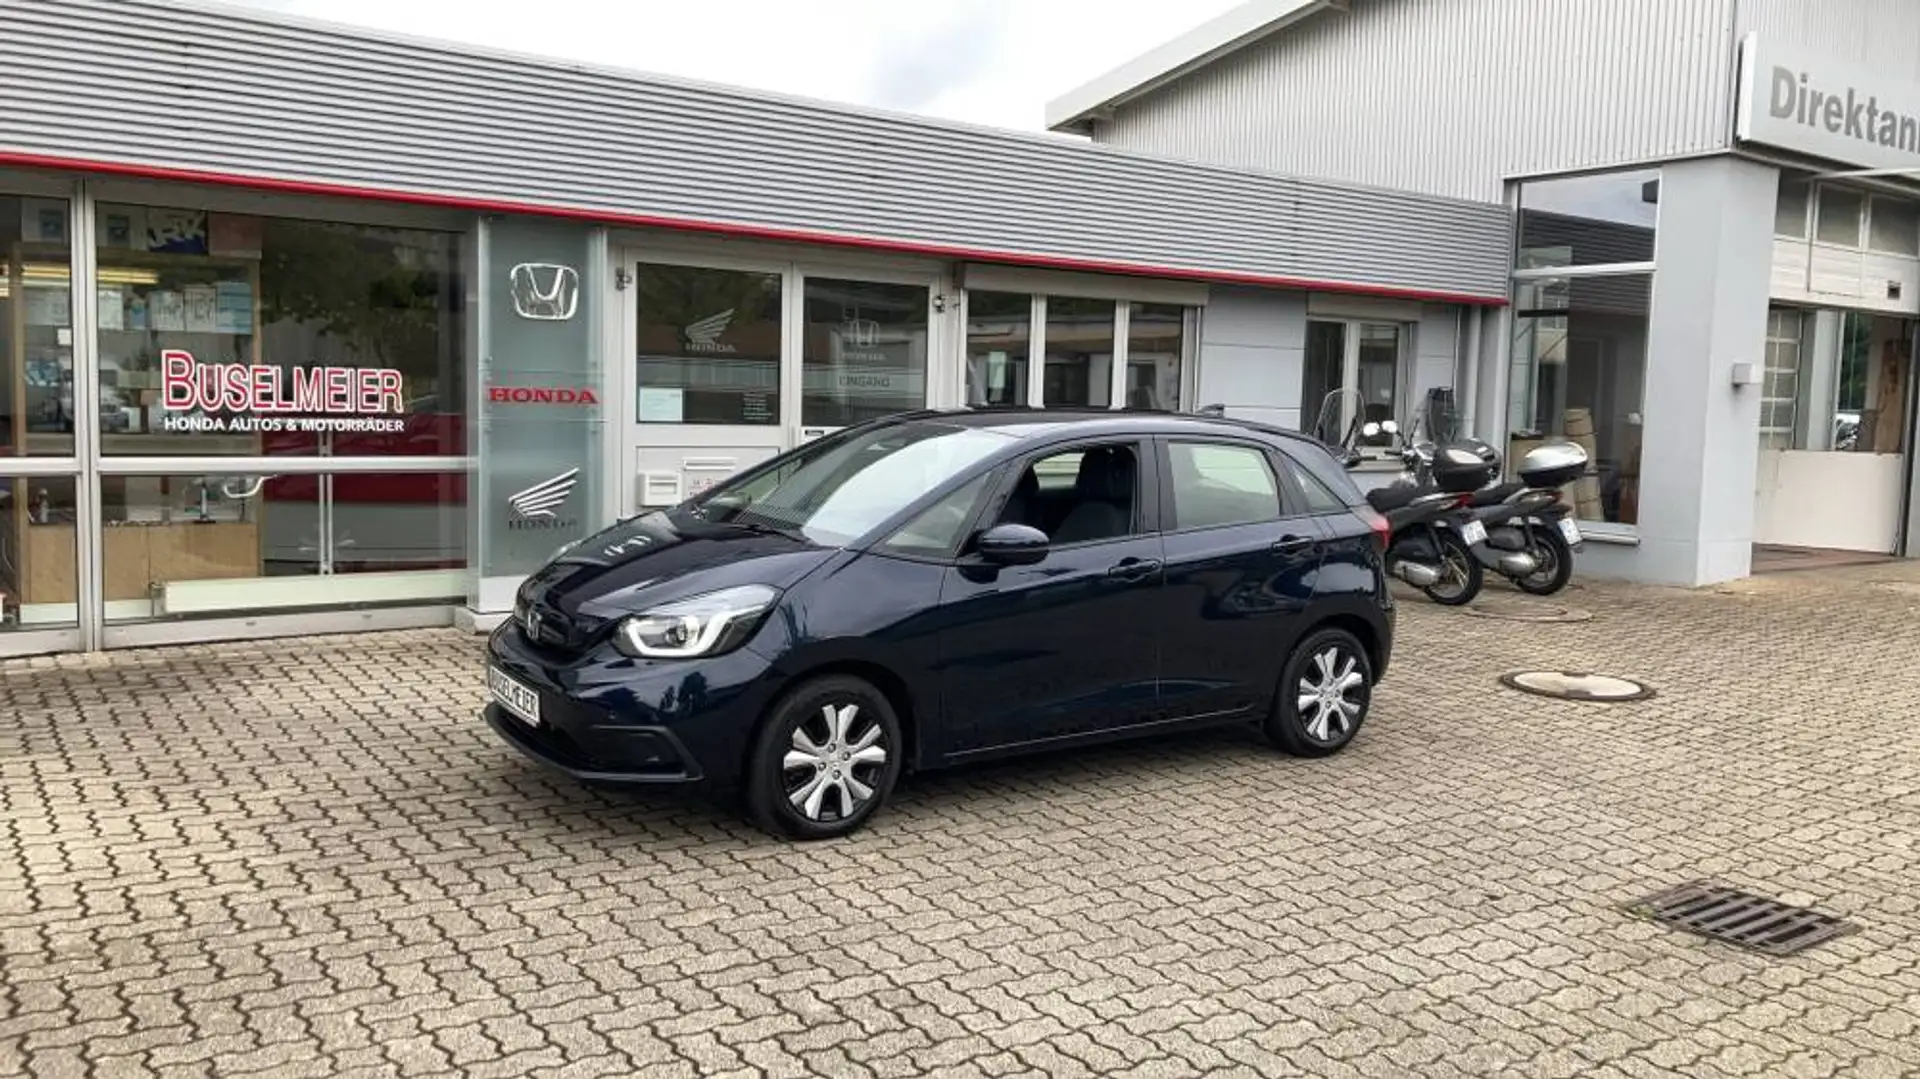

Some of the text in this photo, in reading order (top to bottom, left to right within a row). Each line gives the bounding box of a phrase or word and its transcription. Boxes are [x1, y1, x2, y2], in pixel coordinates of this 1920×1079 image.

[489, 387, 598, 404] HONDA
[164, 414, 404, 432] HONDA AUTOS & MOTORRÄDER
